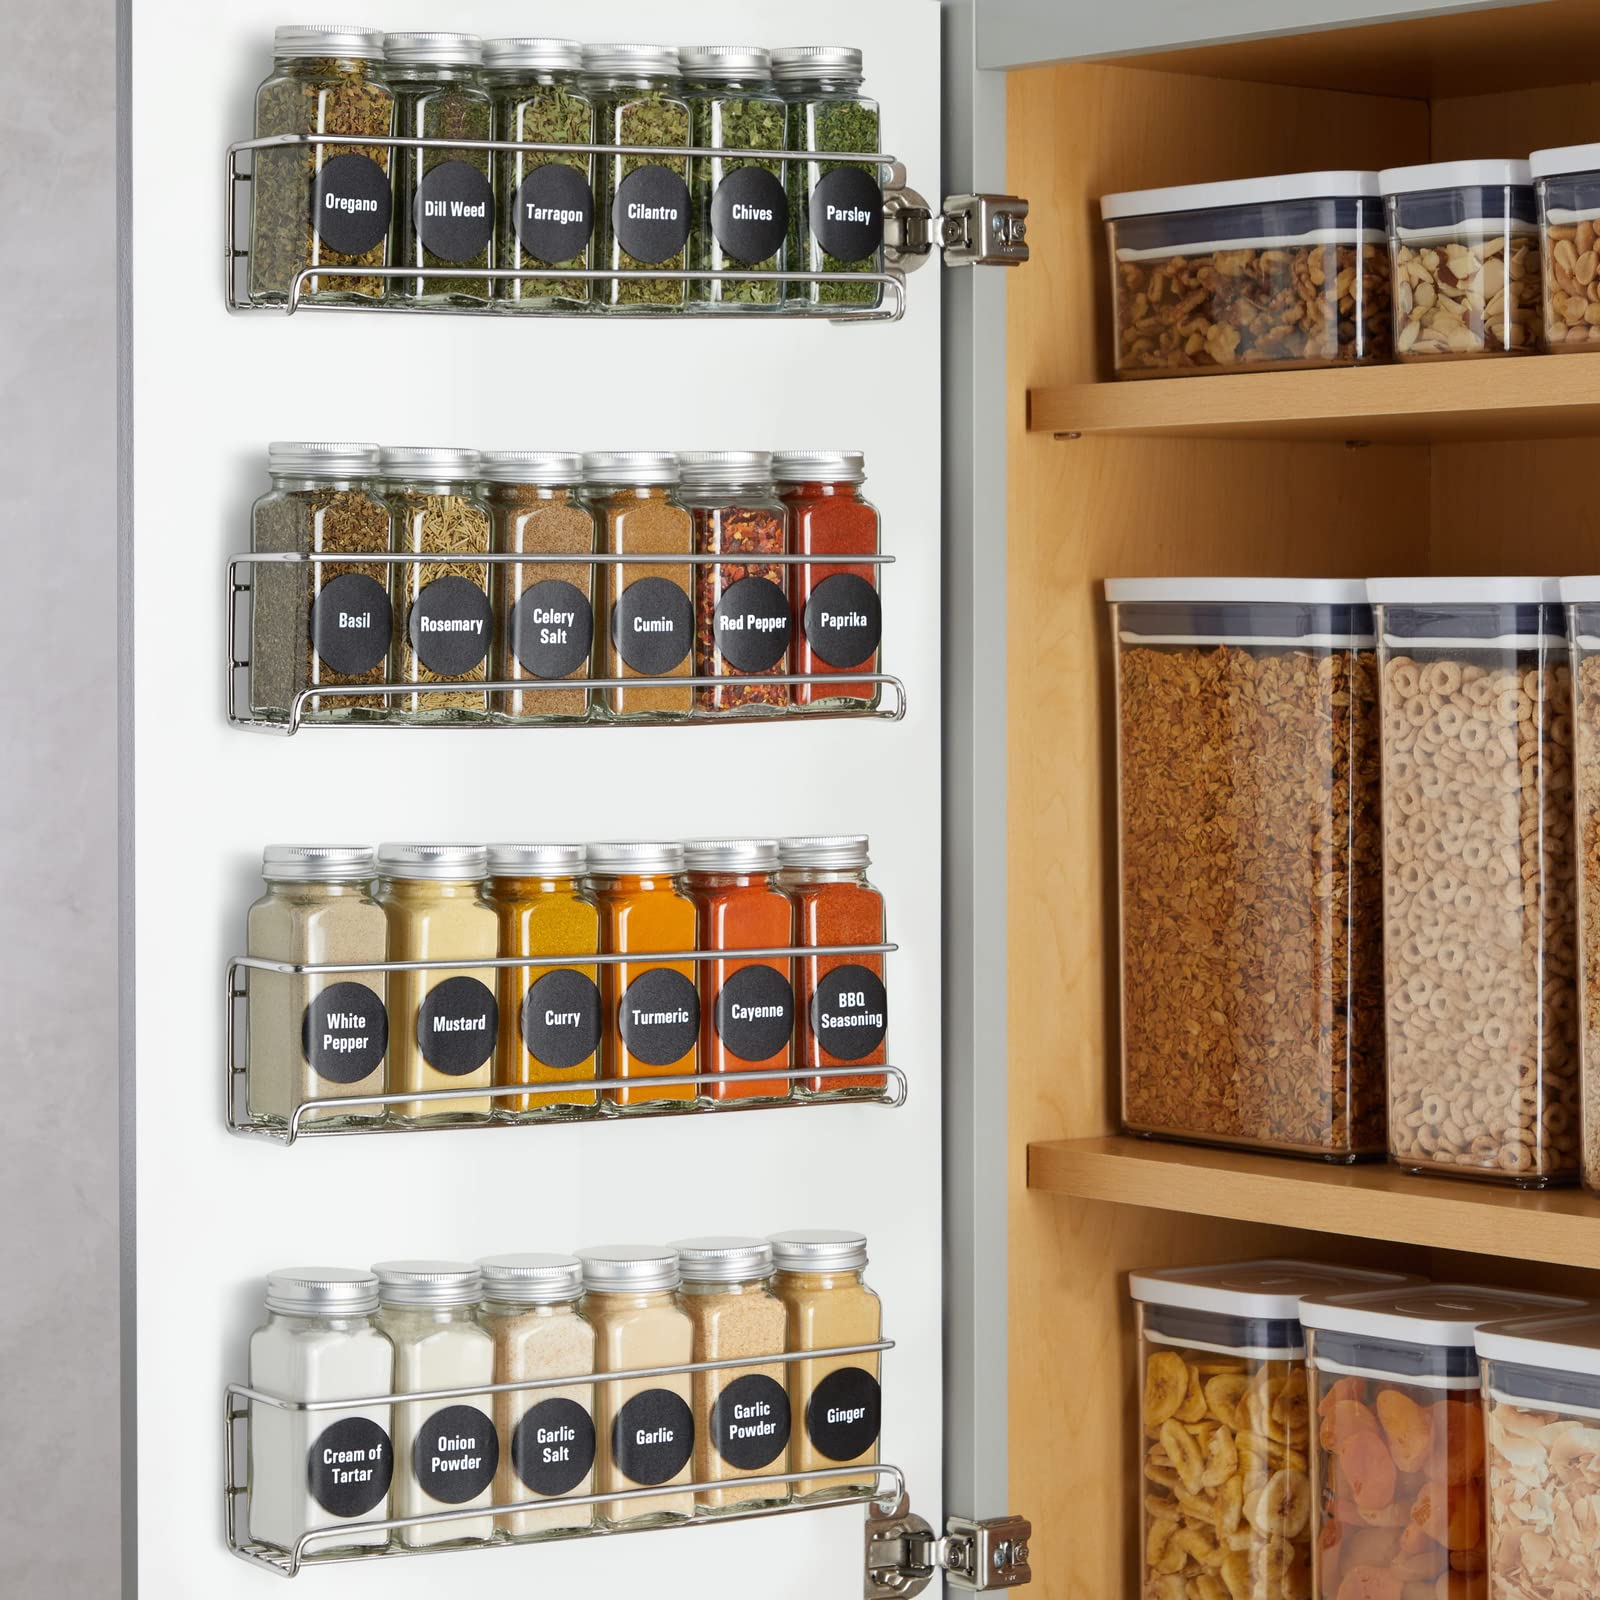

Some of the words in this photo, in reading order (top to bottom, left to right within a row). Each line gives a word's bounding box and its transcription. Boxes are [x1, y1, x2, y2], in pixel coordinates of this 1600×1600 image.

[325, 192, 378, 213] Oregano
[424, 200, 447, 217] Dill
[450, 200, 486, 218] Weed
[627, 203, 678, 221] Cilantro
[525, 203, 583, 225] Tarragon
[732, 204, 773, 221] Chives
[826, 204, 871, 226] Parsley
[338, 612, 371, 629] Basil
[420, 615, 484, 635] Rosemary
[533, 607, 575, 628] Celery
[633, 616, 674, 633] Cumin
[719, 614, 744, 631] Red
[746, 614, 787, 633] Pepper
[820, 611, 868, 631] Paprika
[539, 628, 568, 645] Salt
[838, 991, 866, 1008] BBQ
[326, 1012, 366, 1029] White
[545, 1009, 581, 1028] Curry
[631, 1007, 689, 1026] Turmeric
[731, 1003, 784, 1022] Cayenne
[821, 1010, 883, 1029] Seasoning
[433, 1014, 486, 1033] Mustard
[323, 1034, 369, 1054] Pepper
[734, 1400, 771, 1420] Garlic
[827, 1407, 866, 1424] Ginger
[536, 1425, 575, 1444] Garlic
[636, 1426, 674, 1445] Garlic
[729, 1420, 777, 1440] Powder
[437, 1434, 476, 1452] Onion
[323, 1448, 365, 1465] Cream
[368, 1443, 383, 1461] of
[431, 1454, 482, 1473] Powder
[542, 1445, 570, 1463] Salt
[331, 1468, 373, 1484] Tartar
